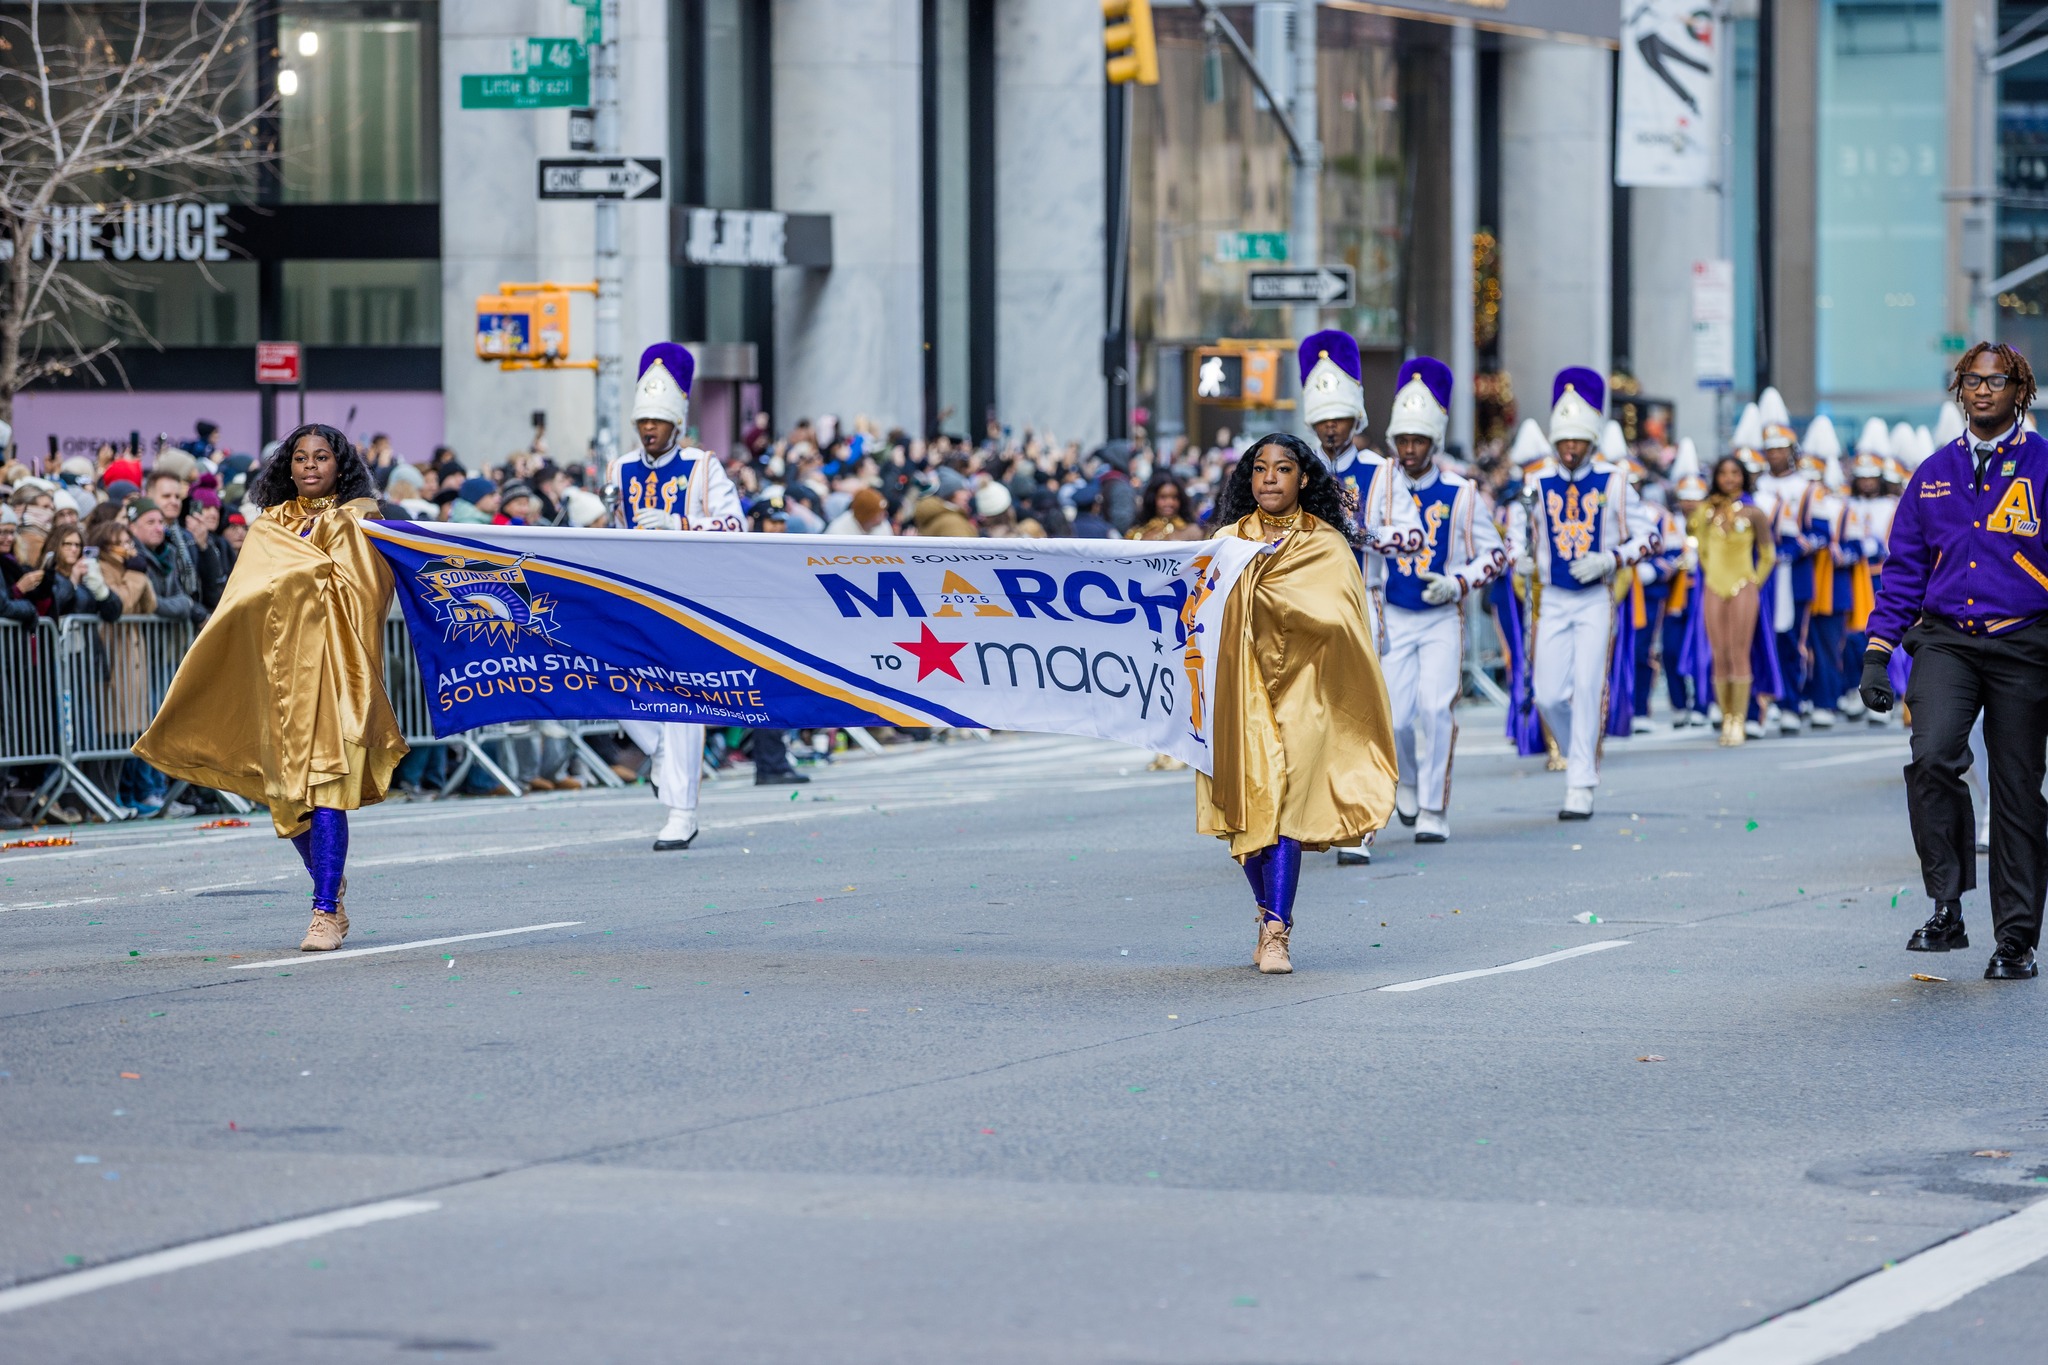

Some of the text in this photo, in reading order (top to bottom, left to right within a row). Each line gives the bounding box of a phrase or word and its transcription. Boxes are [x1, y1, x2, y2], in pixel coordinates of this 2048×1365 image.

[481, 75, 571, 95] Little Brazil
[550, 169, 640, 191] ONE WAY
[111, 202, 231, 262] JUICE
[807, 555, 906, 567] ALCORN
[911, 553, 1009, 564] SOUNDS
[440, 570, 499, 587] SOUNDS
[500, 569, 519, 582] OF
[815, 568, 1188, 645] MARCH
[940, 594, 990, 604] 2025
[870, 654, 902, 671] TO
[437, 655, 538, 694] ALCORN
[440, 673, 765, 712] SOUNDS OF DYN-O-MITE
[631, 699, 770, 724] Lorman, Mississippi
